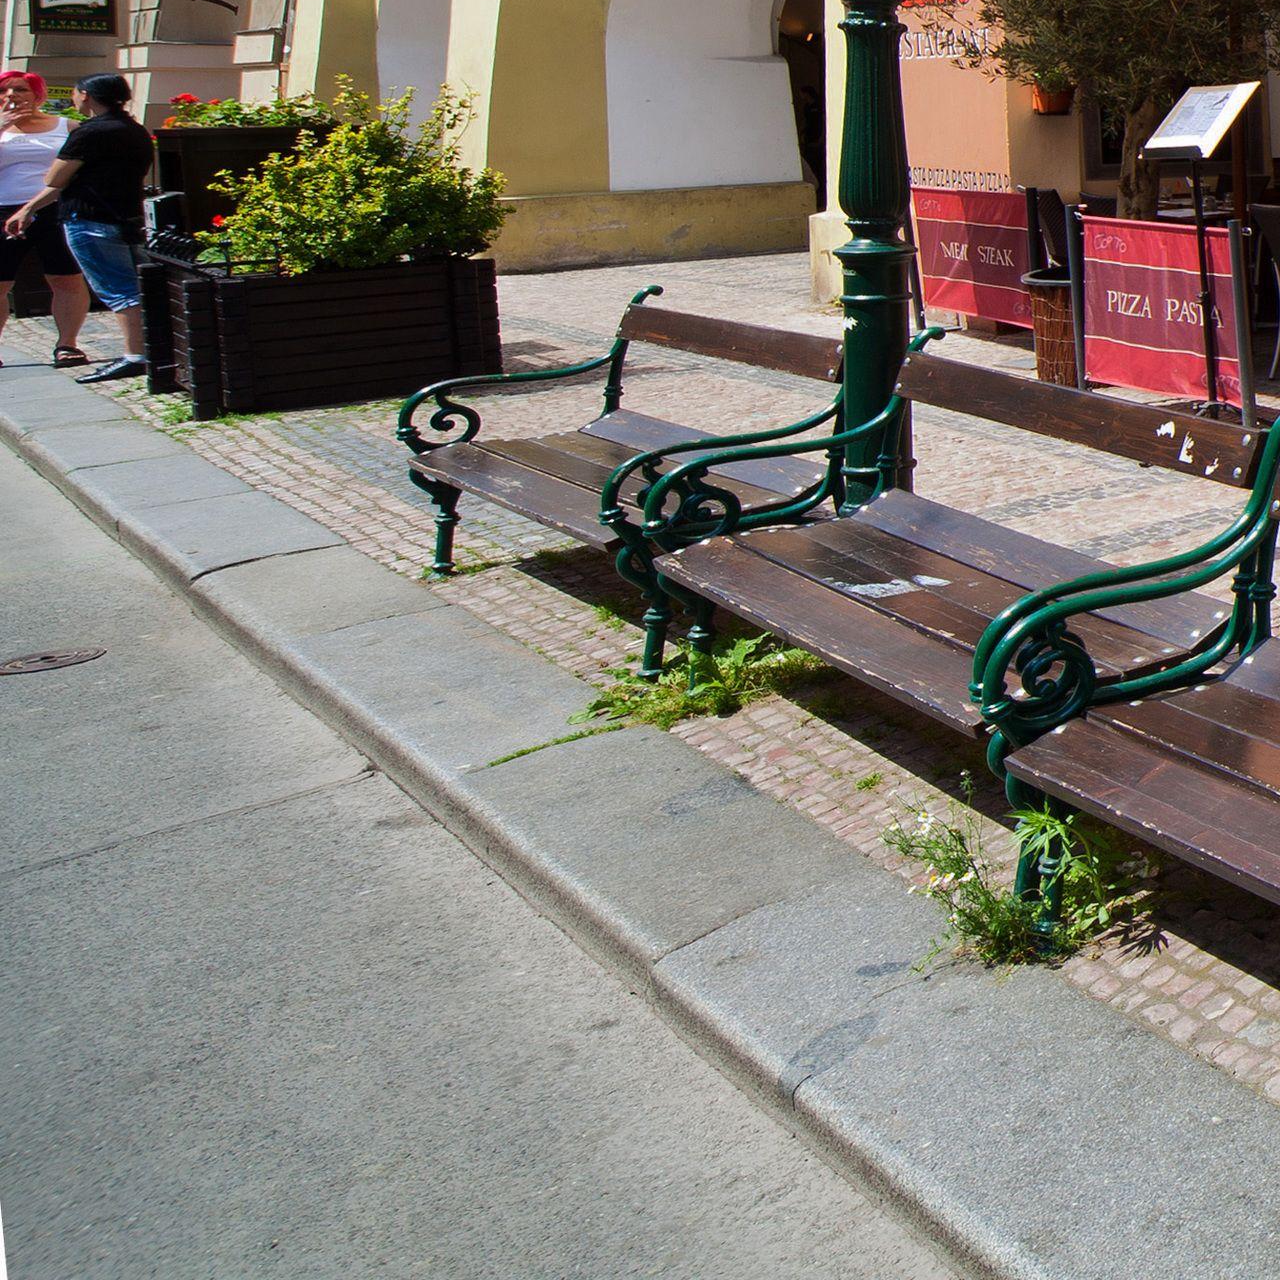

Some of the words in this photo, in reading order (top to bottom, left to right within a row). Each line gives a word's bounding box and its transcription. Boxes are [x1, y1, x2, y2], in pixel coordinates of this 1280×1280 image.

[928, 167, 951, 189] PIZZA
[951, 169, 978, 192] PASTA
[979, 171, 1003, 194] PIZZA
[977, 245, 1015, 267] STEAK
[1107, 289, 1152, 319] PIZZA
